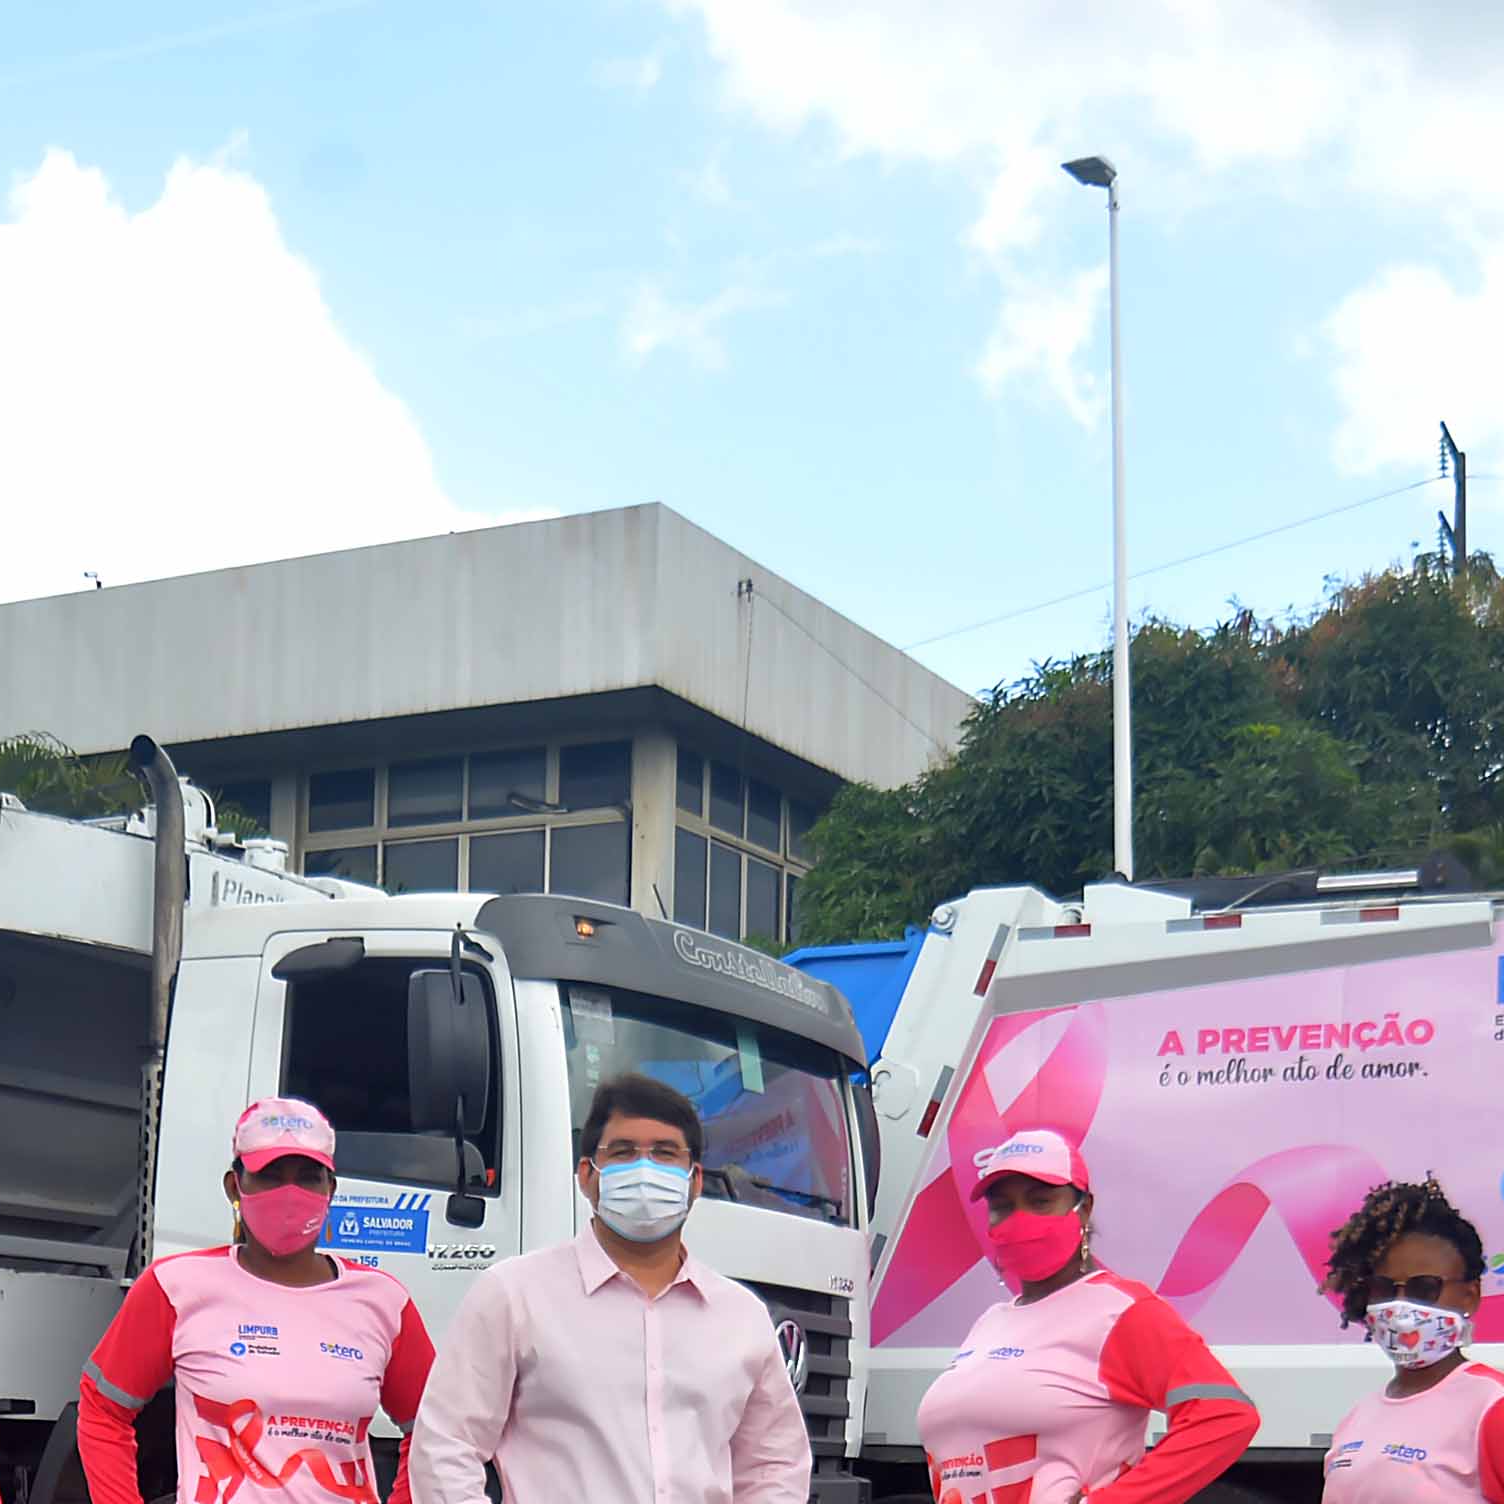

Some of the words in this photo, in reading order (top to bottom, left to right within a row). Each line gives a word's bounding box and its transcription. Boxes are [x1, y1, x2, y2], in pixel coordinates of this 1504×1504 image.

[1156, 1029, 1185, 1057] A
[1196, 1011, 1435, 1055] PREVENÇÃO
[1158, 1063, 1171, 1088] é
[1177, 1072, 1191, 1087] o
[1196, 1057, 1276, 1087] melhor
[1282, 1055, 1319, 1083] ato
[1326, 1053, 1354, 1081] de
[1361, 1060, 1429, 1080] amor.
[363, 1216, 414, 1231] SALVADOR
[359, 1255, 379, 1268] 156
[237, 1324, 279, 1336] LIMPURB
[319, 1341, 364, 1360] sotero
[267, 1415, 277, 1425] A
[280, 1416, 355, 1436] PREVENÇÃO
